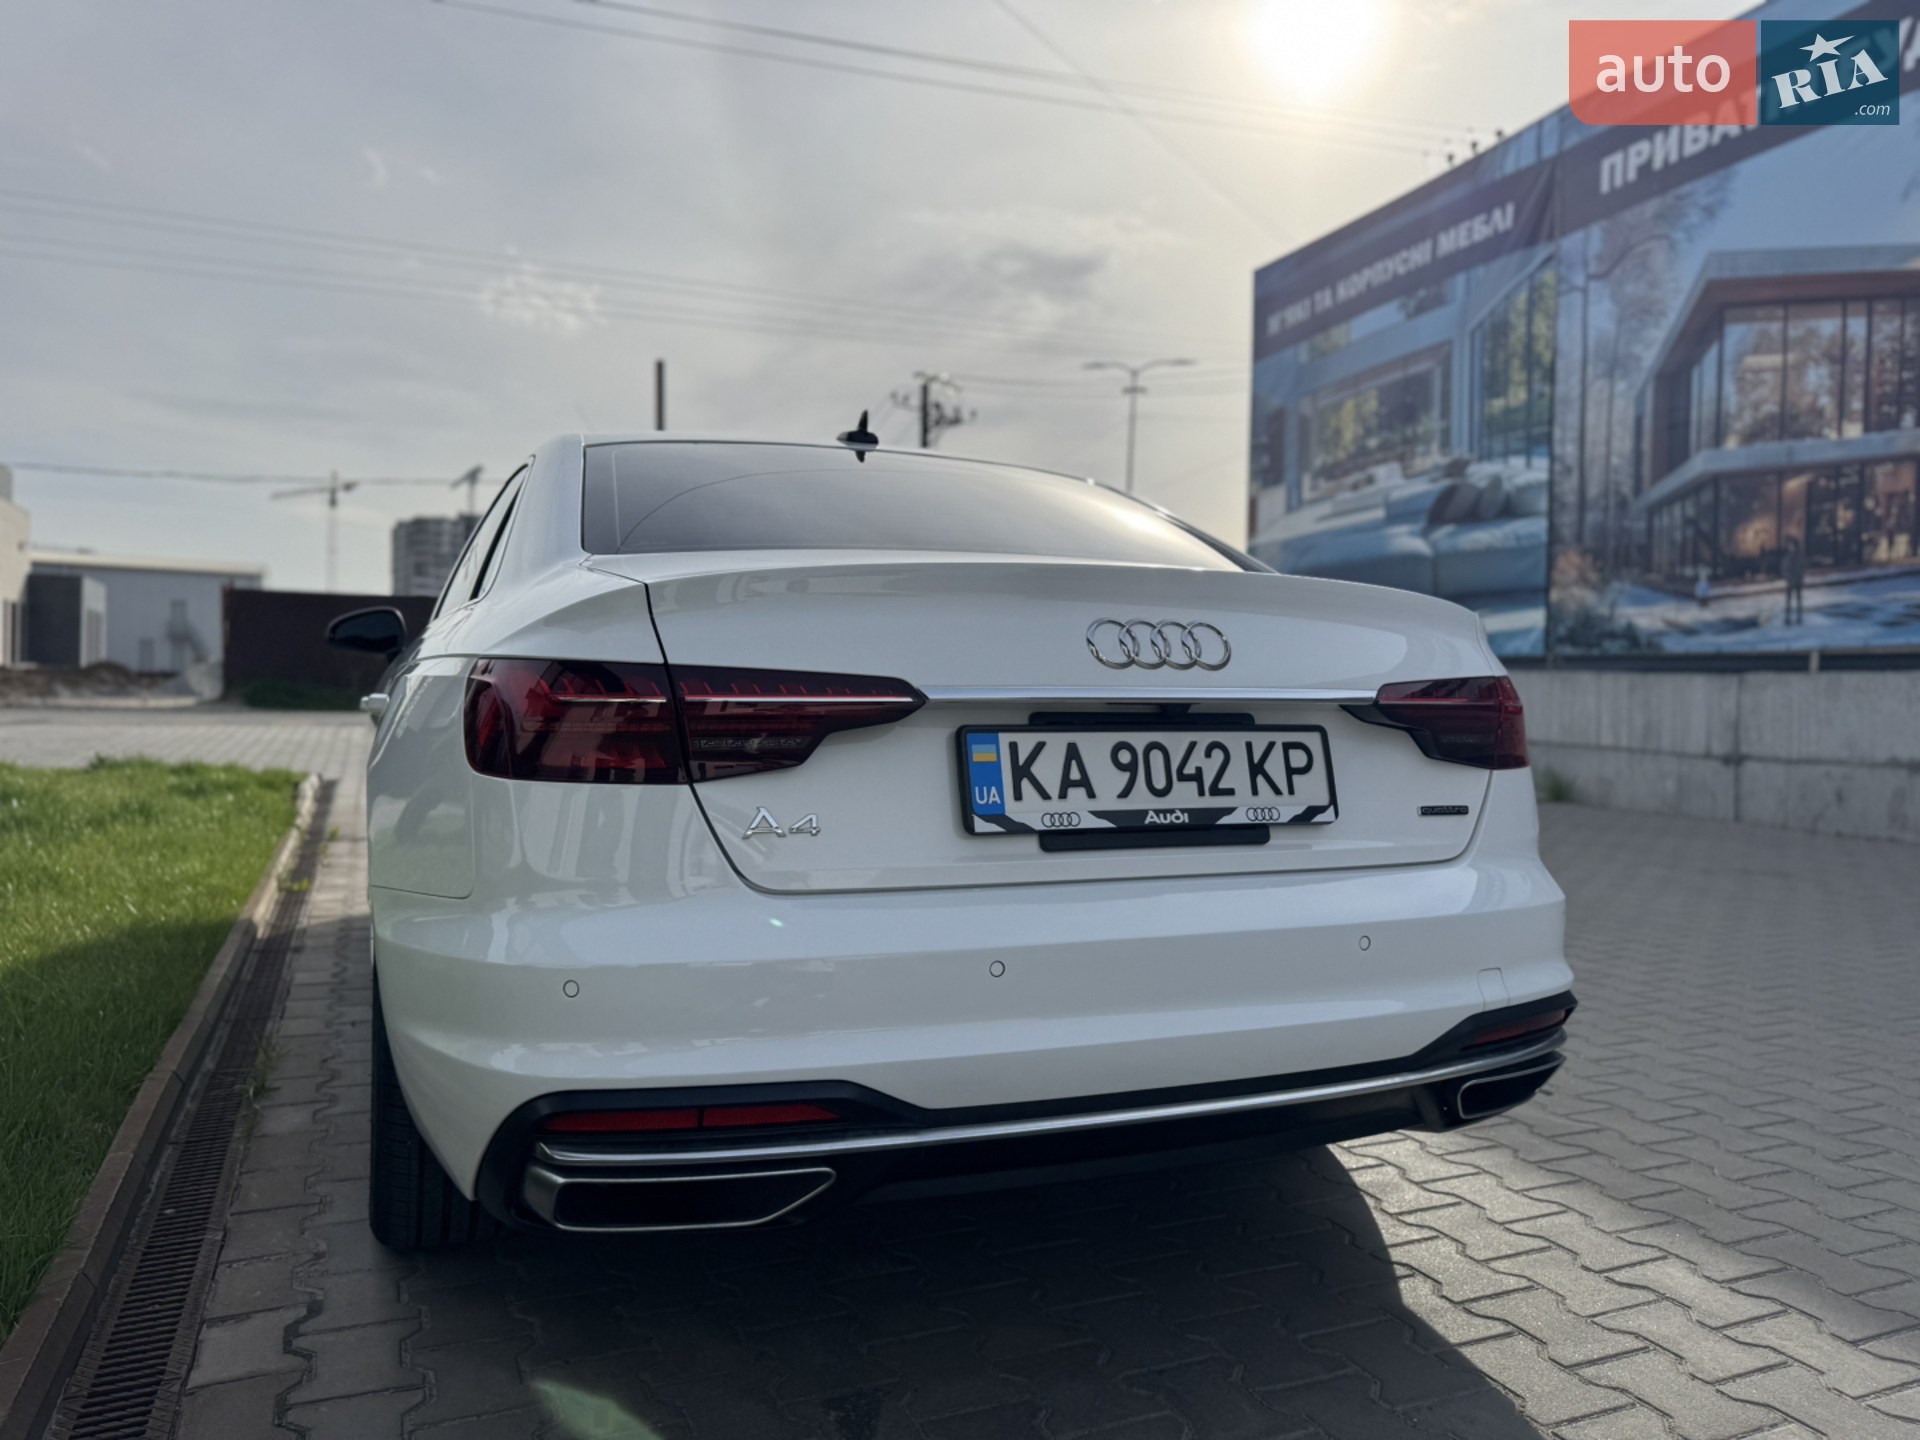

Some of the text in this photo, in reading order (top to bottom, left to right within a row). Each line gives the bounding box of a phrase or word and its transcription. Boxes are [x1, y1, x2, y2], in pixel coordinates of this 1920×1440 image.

[1435, 201, 1515, 259] МЕБЛІ
[1008, 740, 1314, 801] KA 9042 KP
[974, 786, 1001, 806] UA
[742, 806, 821, 840] A4
[1143, 809, 1189, 825] Audi
